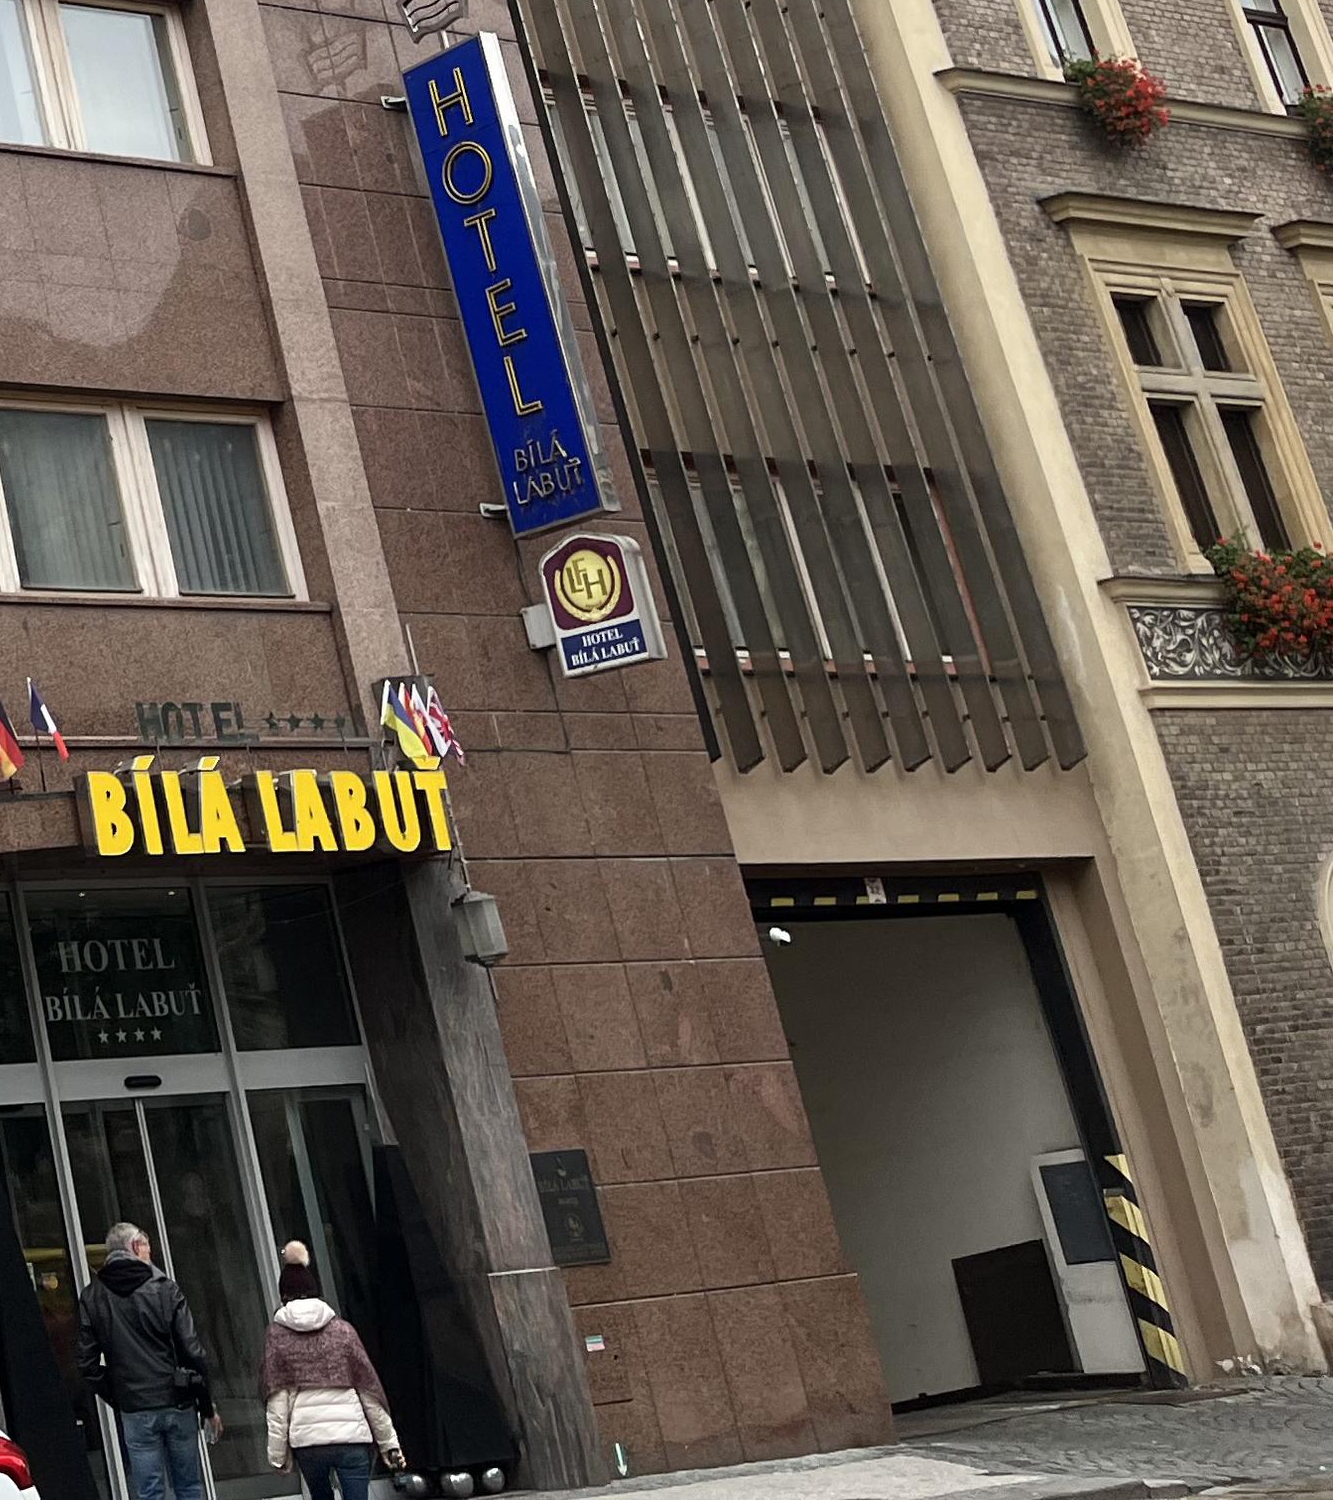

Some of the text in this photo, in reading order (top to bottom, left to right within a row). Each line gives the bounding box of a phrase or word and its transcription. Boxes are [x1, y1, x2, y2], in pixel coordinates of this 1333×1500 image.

[428, 67, 543, 416] HOTEL
[513, 429, 568, 472] BÍLÁ
[571, 646, 600, 666] BÍLÁ
[582, 627, 624, 647] HOTEL
[135, 702, 261, 744] HOTEL
[87, 754, 452, 857] BÍLÁ LABUŤ
[57, 938, 175, 973] HOTEL
[45, 981, 202, 1022] BÍLÁ LABUŤ
